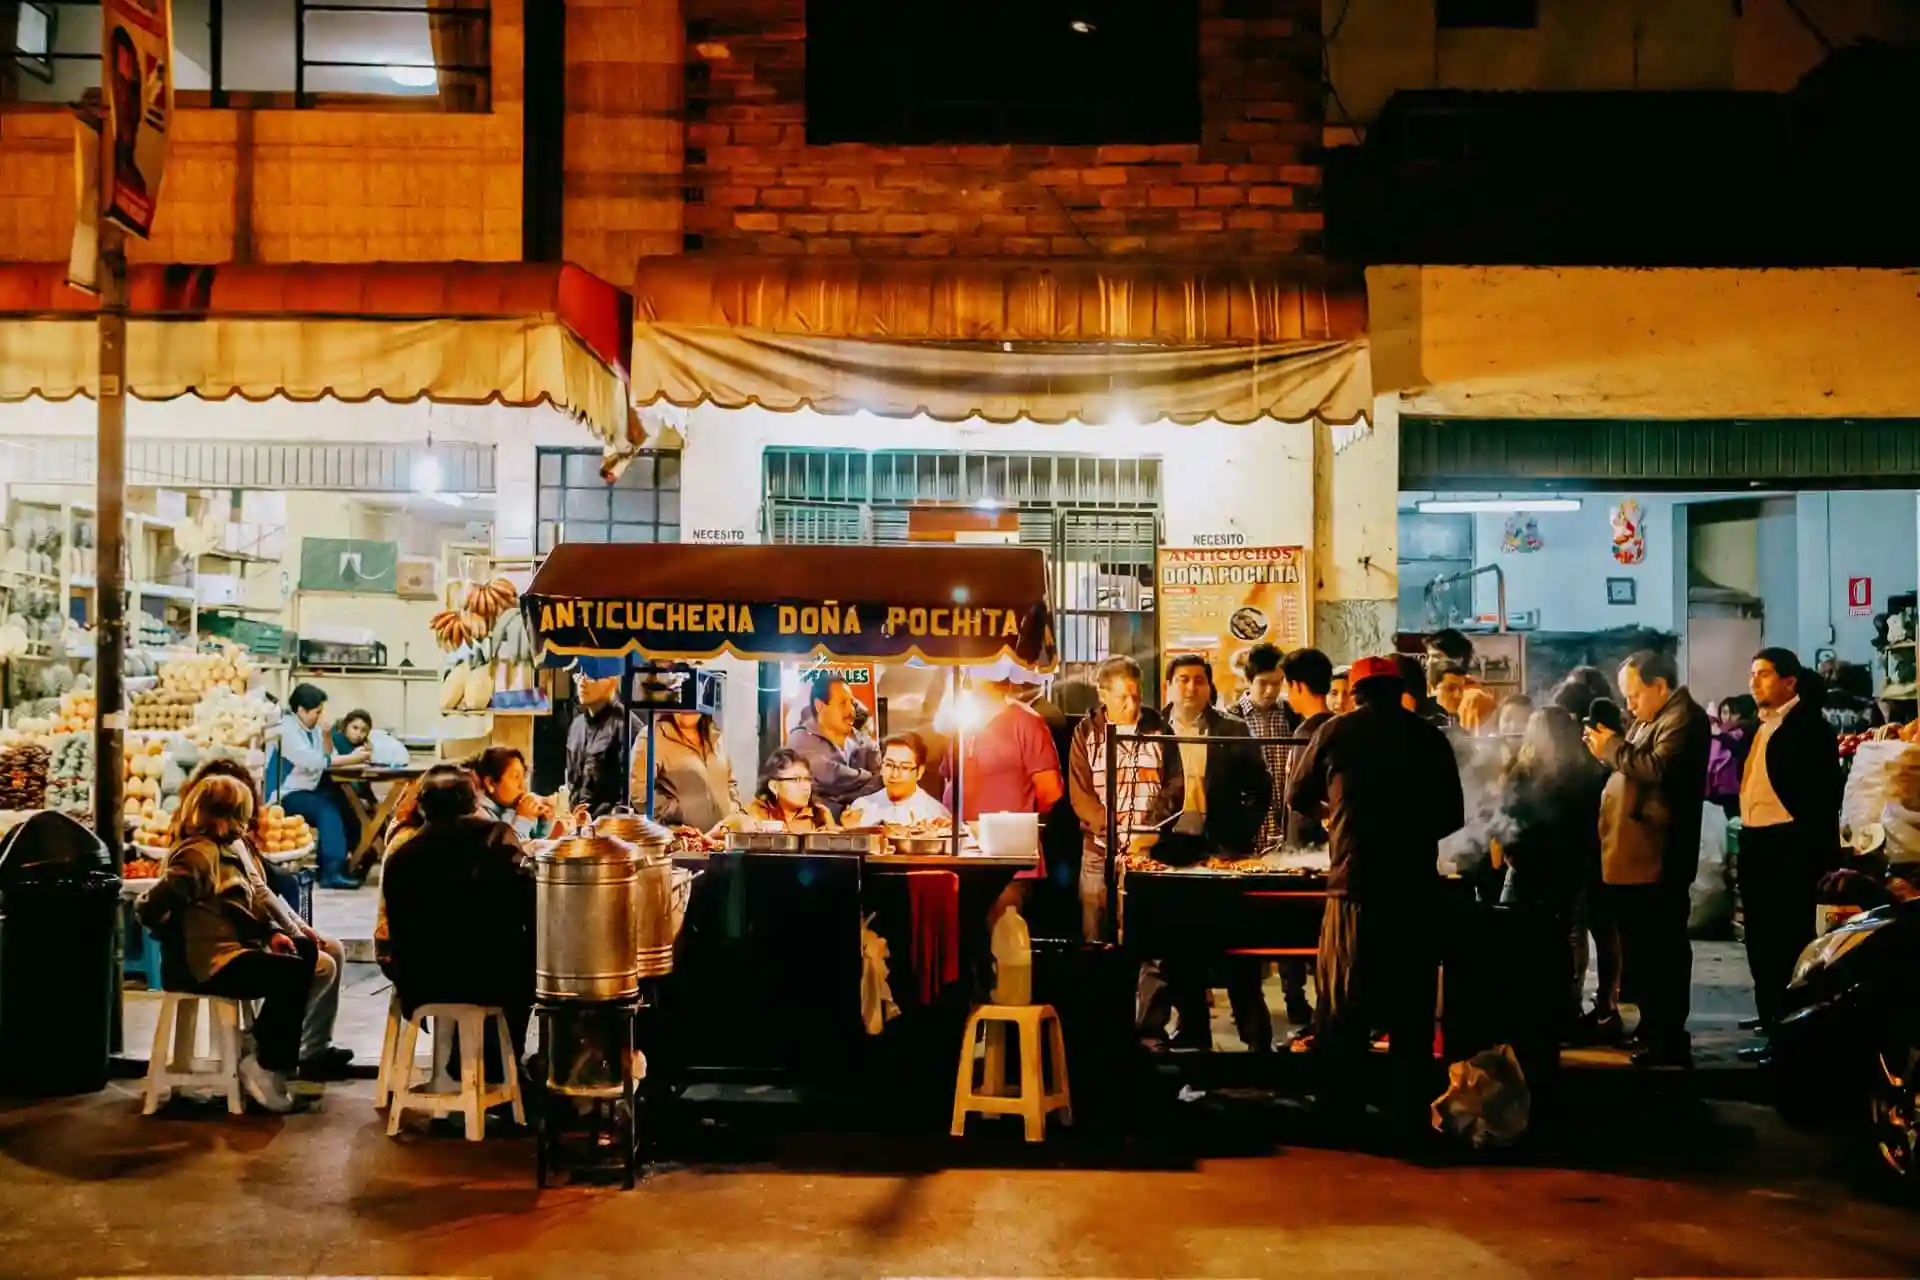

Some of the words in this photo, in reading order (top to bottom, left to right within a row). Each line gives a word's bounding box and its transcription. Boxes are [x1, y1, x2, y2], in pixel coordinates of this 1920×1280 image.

[692, 529, 745, 540] NECESITO
[1193, 533, 1244, 545] NECESITO
[1169, 548, 1292, 561] ANTICUCHOS
[1161, 564, 1215, 585] DOÑA
[1218, 565, 1299, 584] POCHITA
[539, 600, 755, 633] ANTICUCHERIA
[779, 600, 862, 635] DOÑA
[886, 606, 1019, 636] POCHITA
